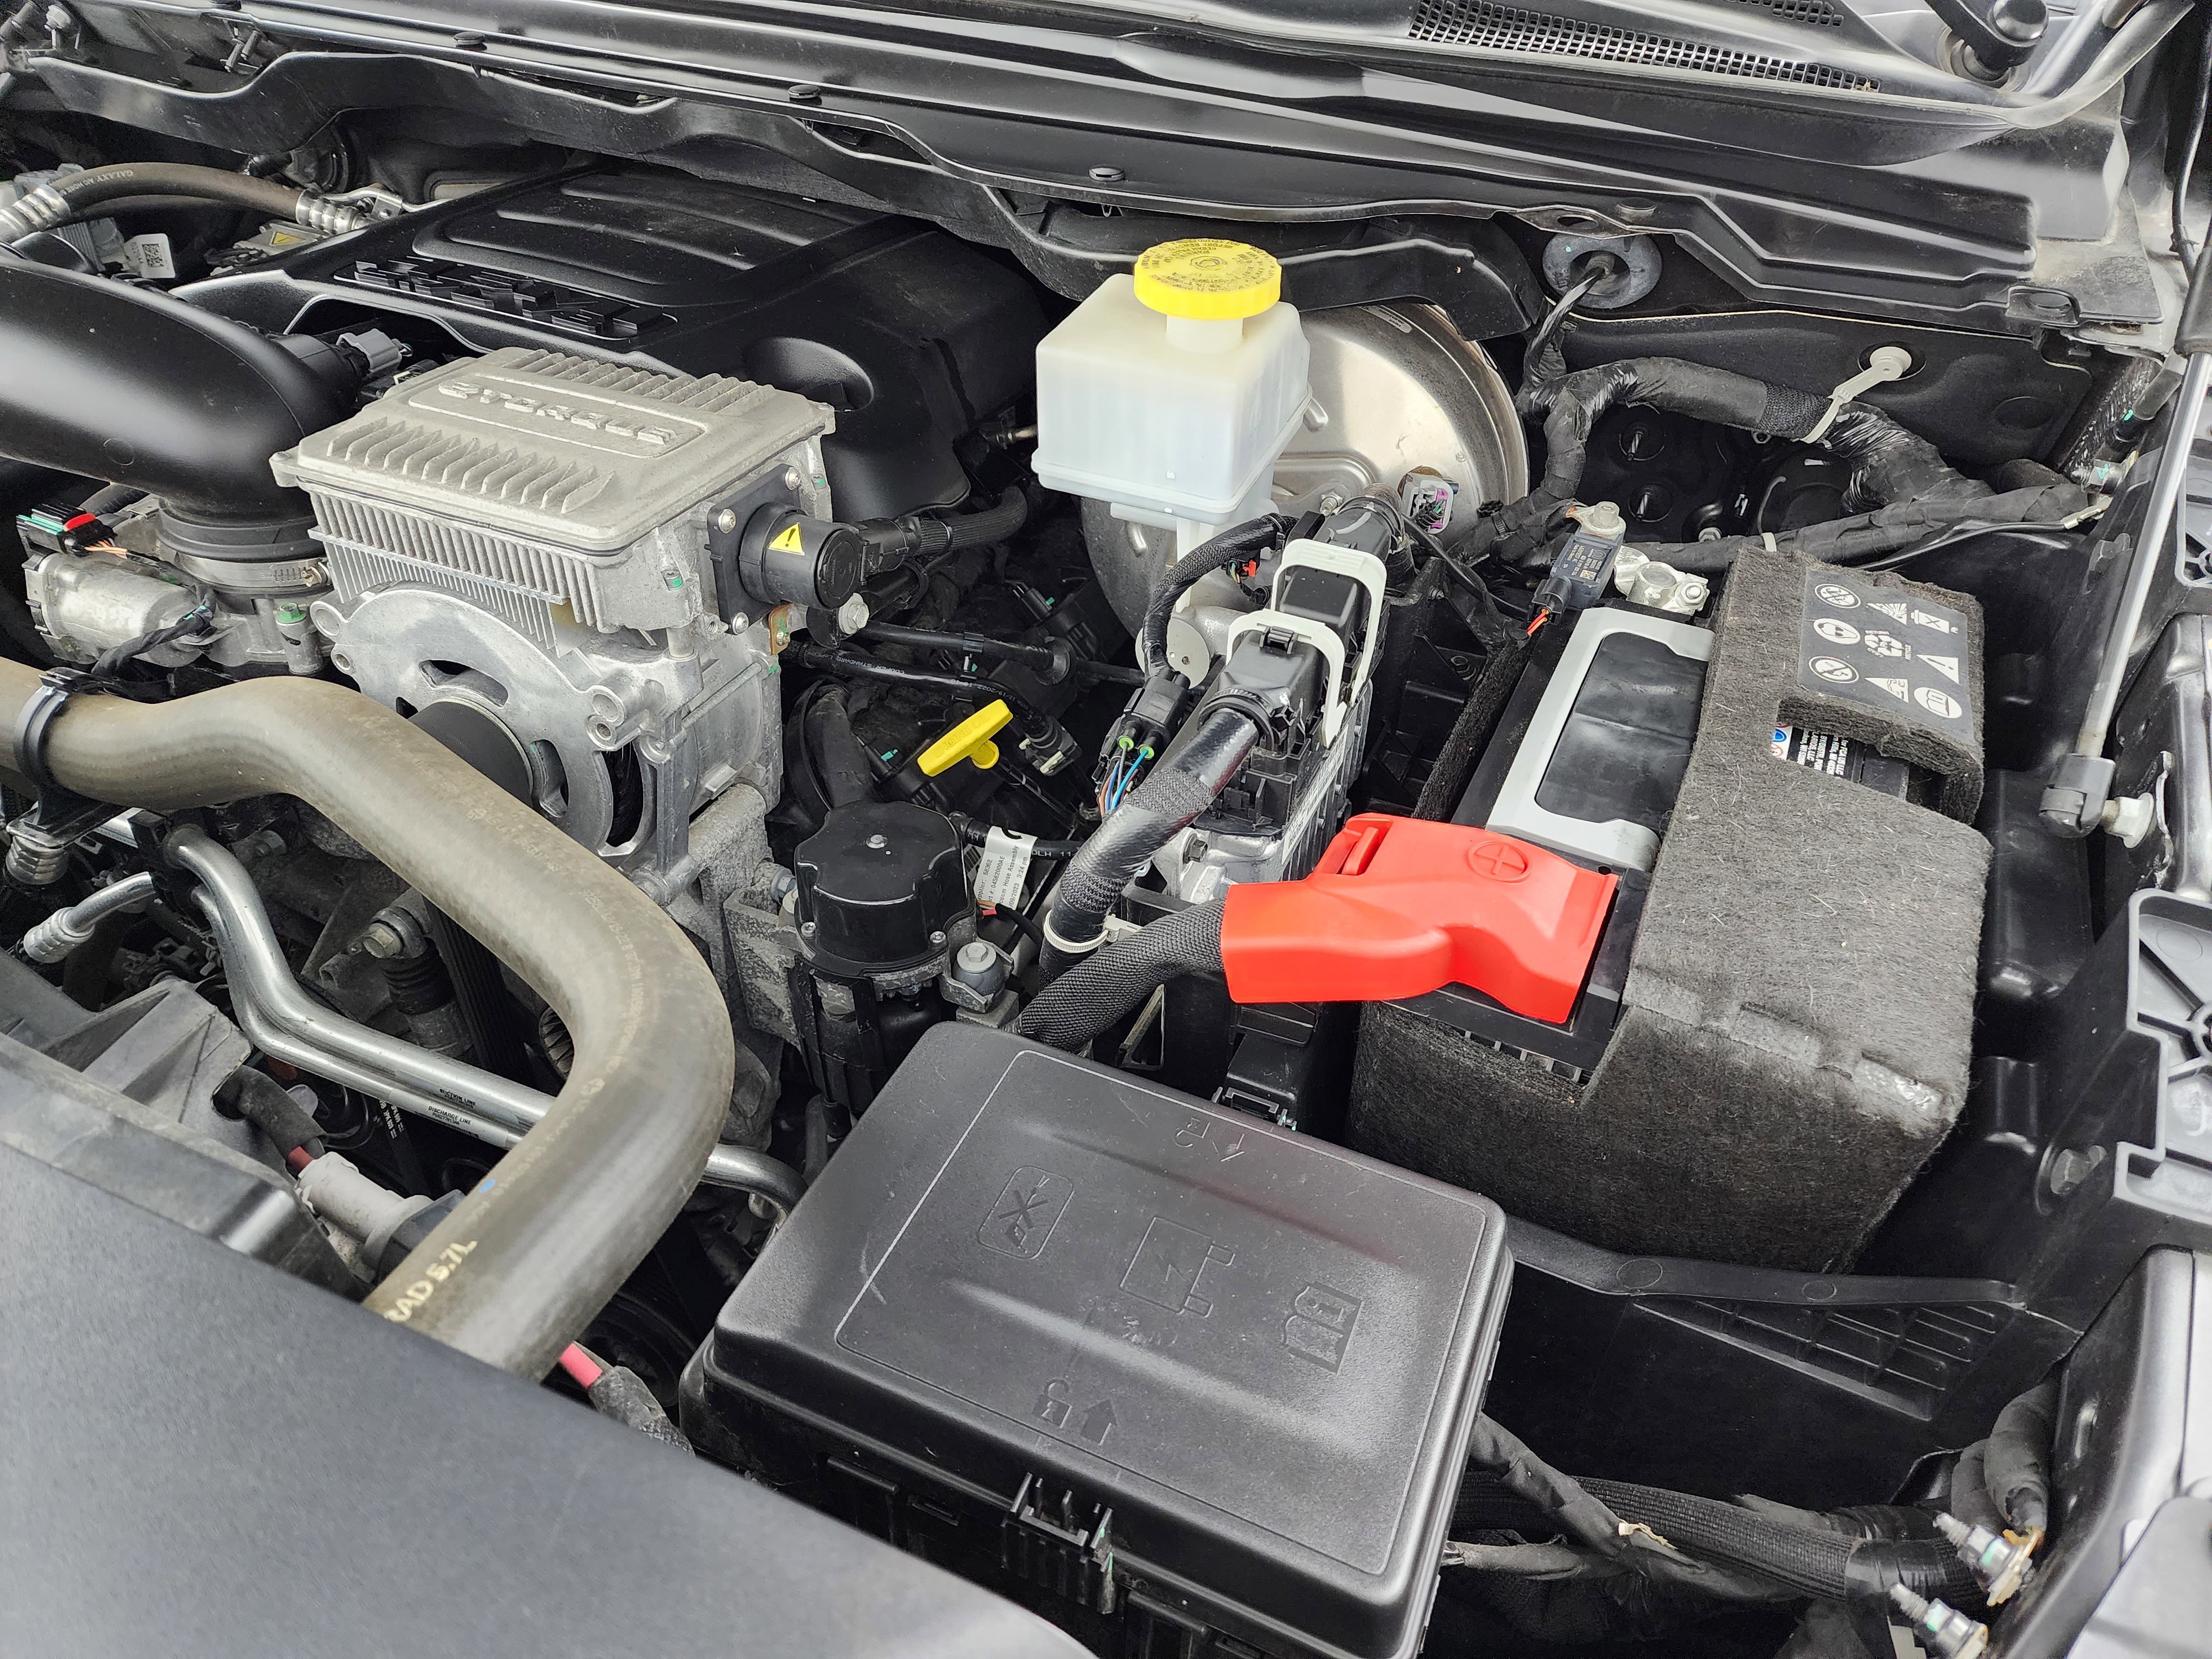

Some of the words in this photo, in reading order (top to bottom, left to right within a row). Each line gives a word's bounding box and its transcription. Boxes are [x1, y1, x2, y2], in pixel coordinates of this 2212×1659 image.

[97, 170, 133, 182] GALAXY
[836, 656, 873, 668] STANDARD
[877, 665, 905, 675] COOPER
[935, 728, 972, 758] ENGINE
[972, 713, 991, 728] OIL
[1839, 747, 1848, 757] FCA
[1008, 844, 1020, 872] Assembly
[1002, 872, 1011, 886] Hose
[1008, 883, 1020, 907] /09/2023
[1016, 866, 1025, 879] 3:24
[1021, 856, 1028, 865] pm
[977, 879, 987, 900] upplier:
[998, 888, 1007, 904] cuum
[463, 1098, 476, 1107] LINE
[427, 1106, 459, 1120] DISCHARGE
[459, 1117, 472, 1125] LINE
[425, 1241, 478, 1283] 5.7L
